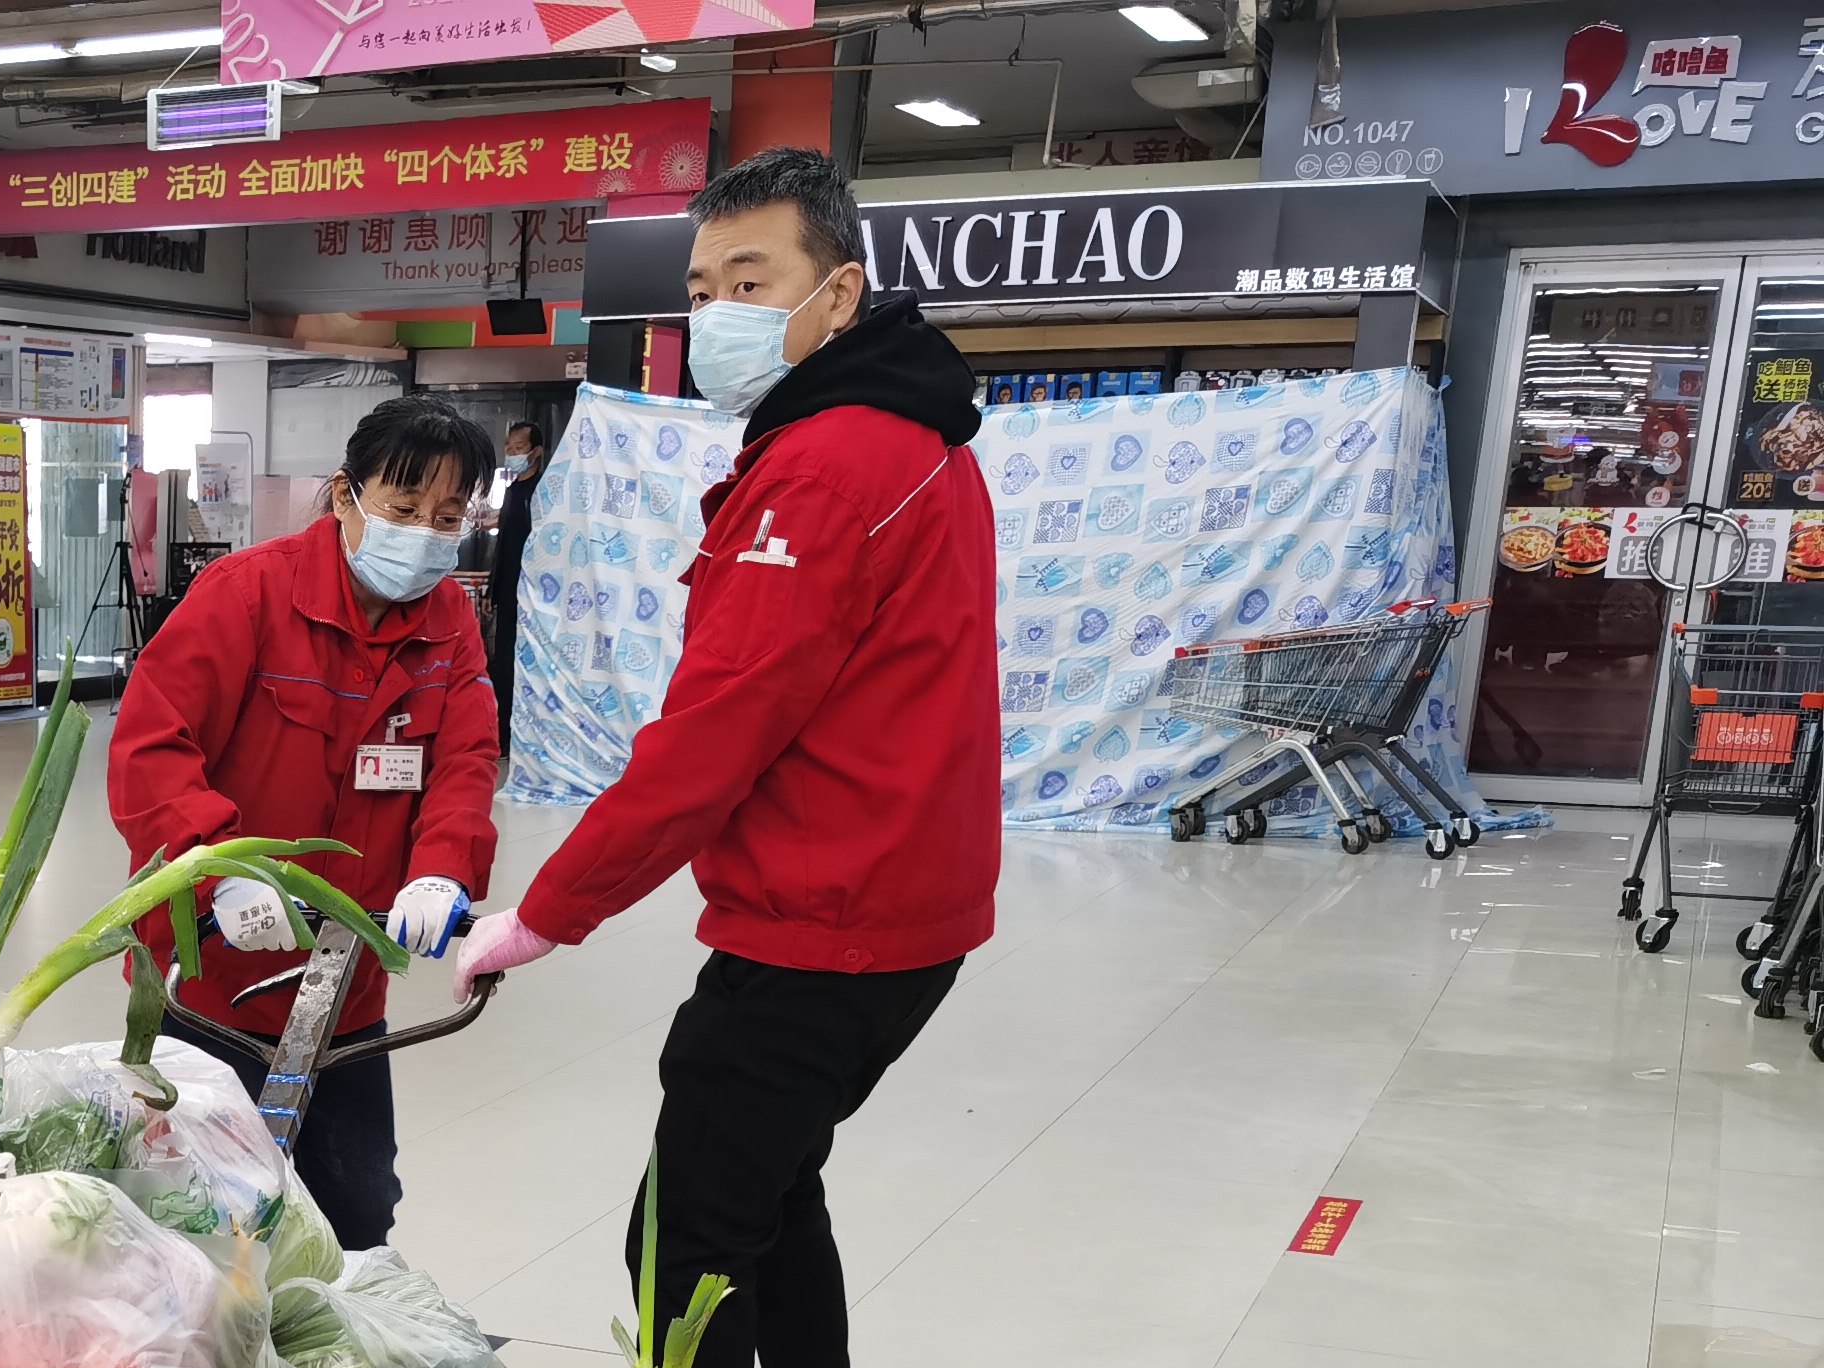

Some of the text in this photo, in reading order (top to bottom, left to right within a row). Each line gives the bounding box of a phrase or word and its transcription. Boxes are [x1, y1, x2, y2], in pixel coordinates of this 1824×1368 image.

[1303, 120, 1415, 146] NO.1047
[9, 166, 149, 208] “三创四建”
[166, 162, 227, 201] 活动
[239, 153, 364, 196] 全面加快
[384, 137, 545, 185] “四个体系”
[563, 132, 635, 174] 建设
[315, 213, 488, 256] 谢谢惠顾
[381, 259, 440, 281] Thank
[445, 260, 479, 283] you
[529, 255, 584, 276] pleas
[1235, 263, 1415, 292] 潮品数码生活馆
[1754, 378, 1781, 401] 送
